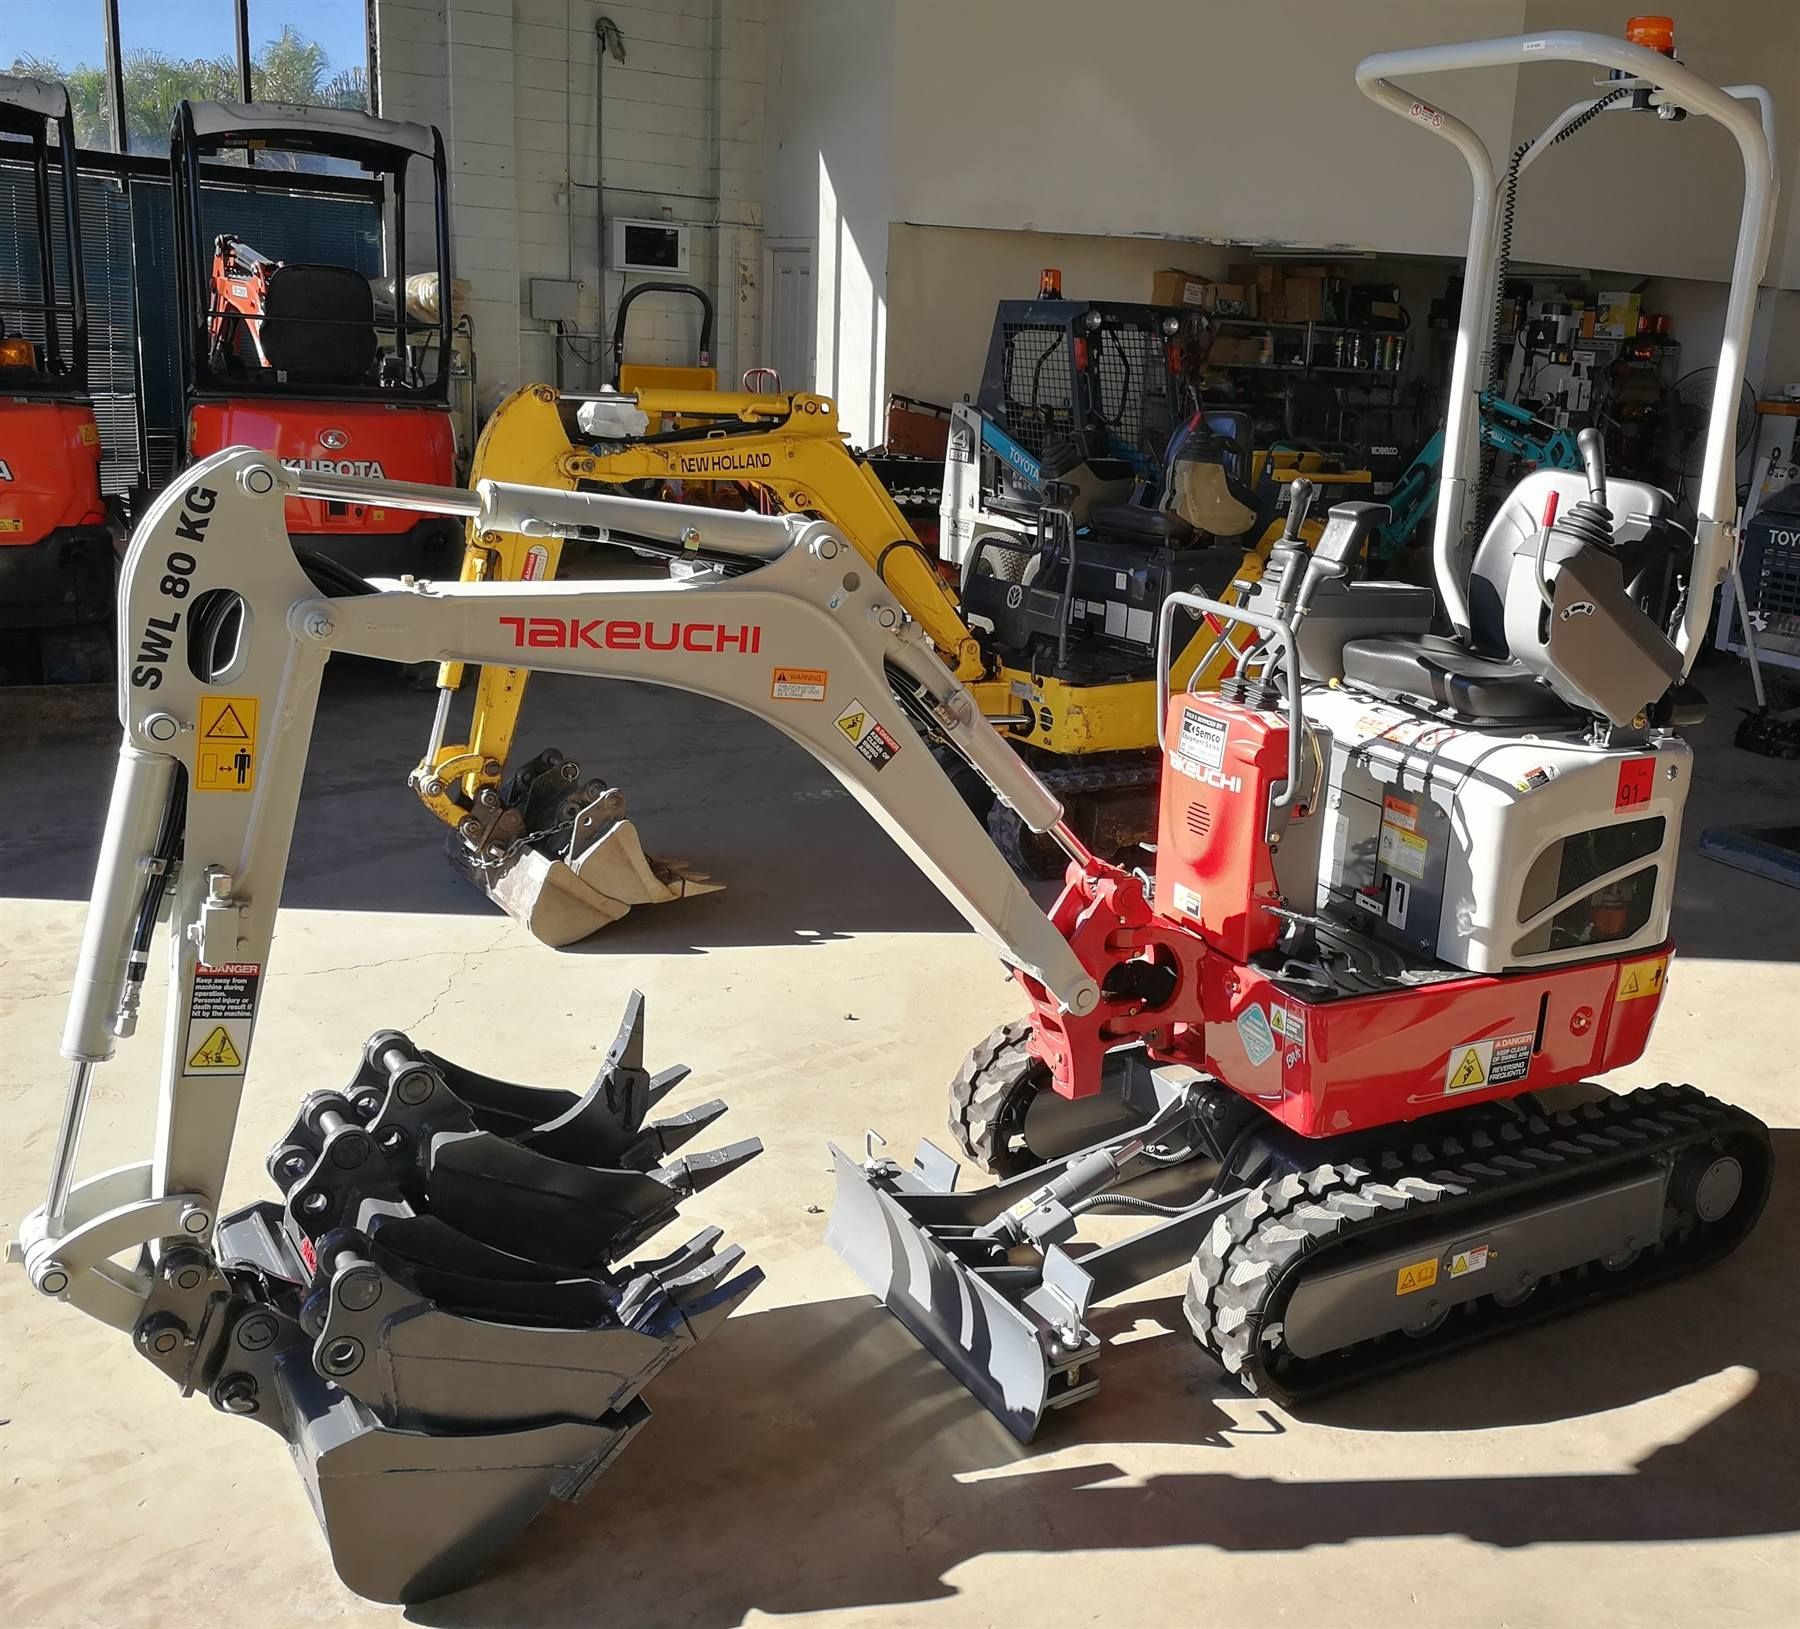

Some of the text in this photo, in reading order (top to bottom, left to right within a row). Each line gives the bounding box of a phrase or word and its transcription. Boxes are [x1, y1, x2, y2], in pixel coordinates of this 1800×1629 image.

[681, 453, 772, 474] NEW HOLLAND
[1009, 446, 1040, 481] TOYOTA
[131, 486, 218, 690] SWL 80 KG
[499, 616, 761, 654] TAKEUCHI
[871, 731, 885, 746] KEEP
[1195, 726, 1221, 744] Semco
[861, 741, 879, 758] SWING
[866, 736, 884, 753] CLEAR
[858, 746, 873, 761] AREA
[209, 964, 258, 974] DANGER
[196, 977, 213, 985] Keep
[223, 984, 244, 992] during
[1502, 1034, 1532, 1047] DANGER
[1497, 1046, 1527, 1056] KEEP CLEAR
[1489, 1067, 1526, 1081] FREQUENTLY
[1492, 1061, 1525, 1074] REVERSING
